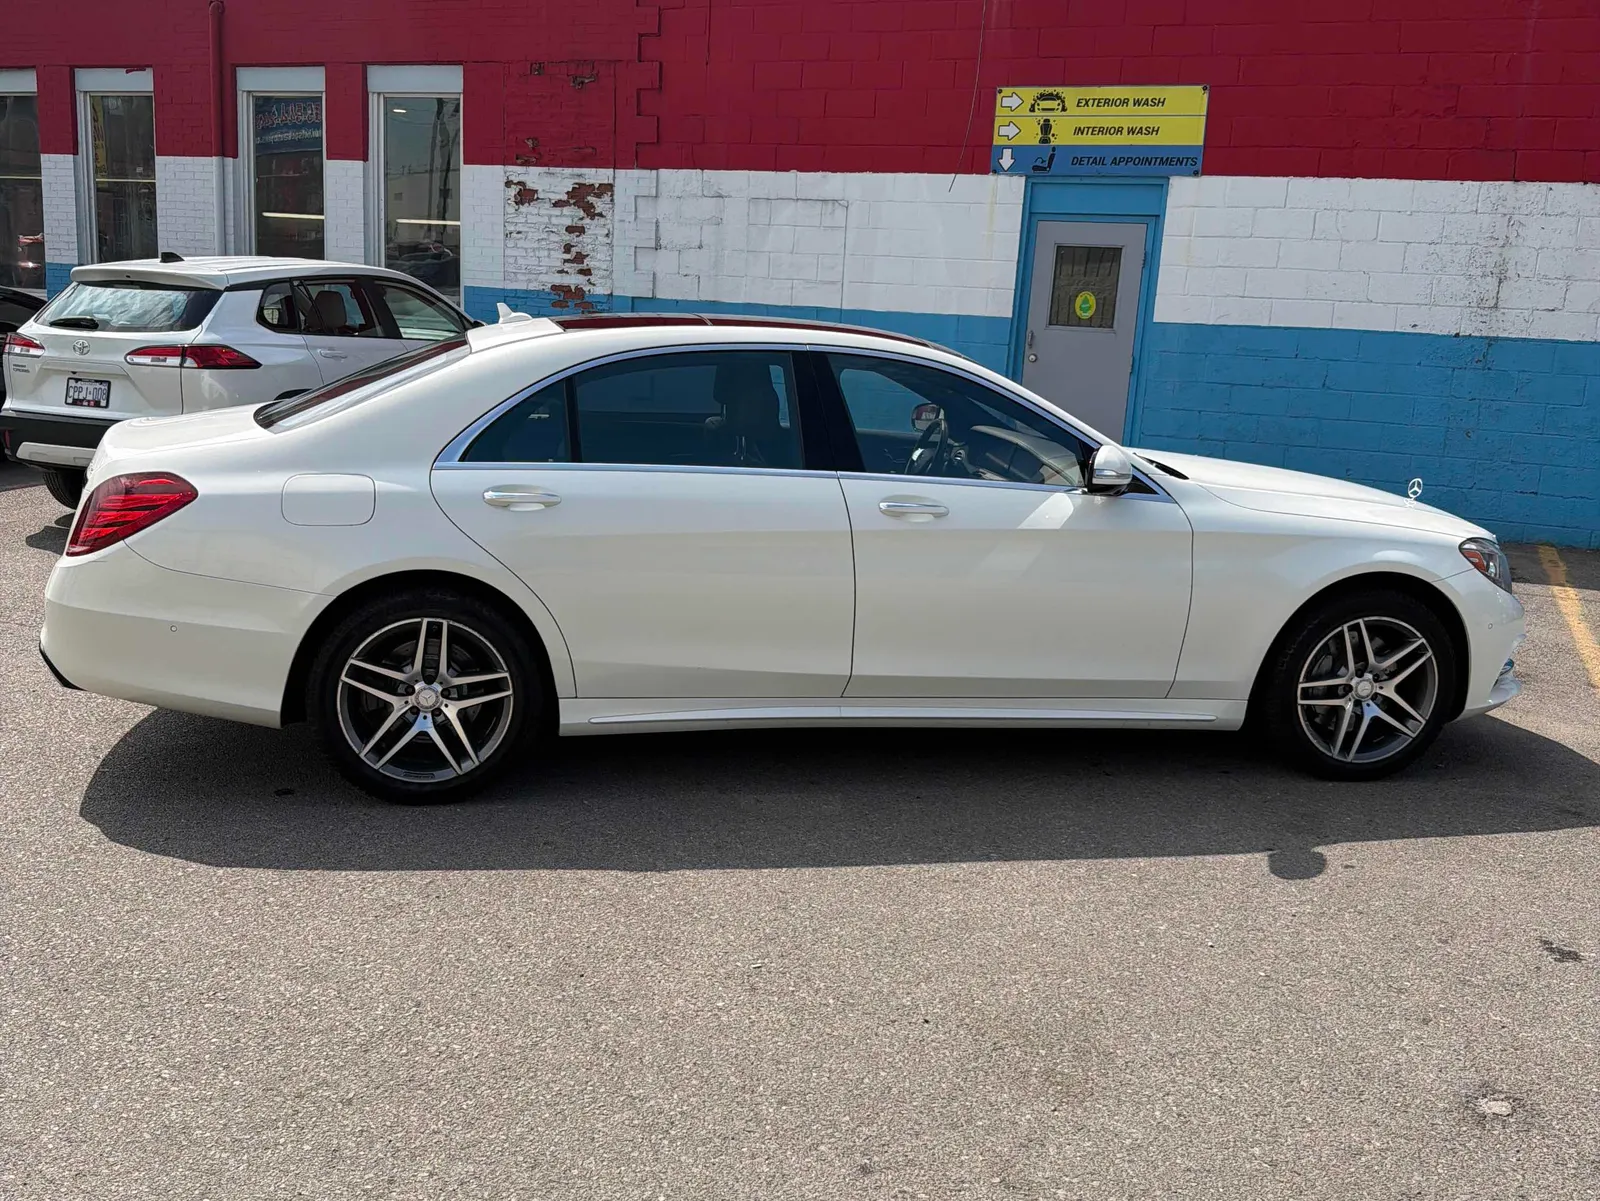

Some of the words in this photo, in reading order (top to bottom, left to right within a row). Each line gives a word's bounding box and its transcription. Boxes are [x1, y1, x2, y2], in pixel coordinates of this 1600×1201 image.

[1076, 98, 1129, 108] EXTERIOR
[1132, 97, 1166, 107] WASH
[1073, 126, 1124, 136] INTERIOR
[1126, 126, 1160, 136] WASH
[1071, 156, 1107, 166] DETAIL
[1110, 156, 1198, 167] APPOINTMENTS
